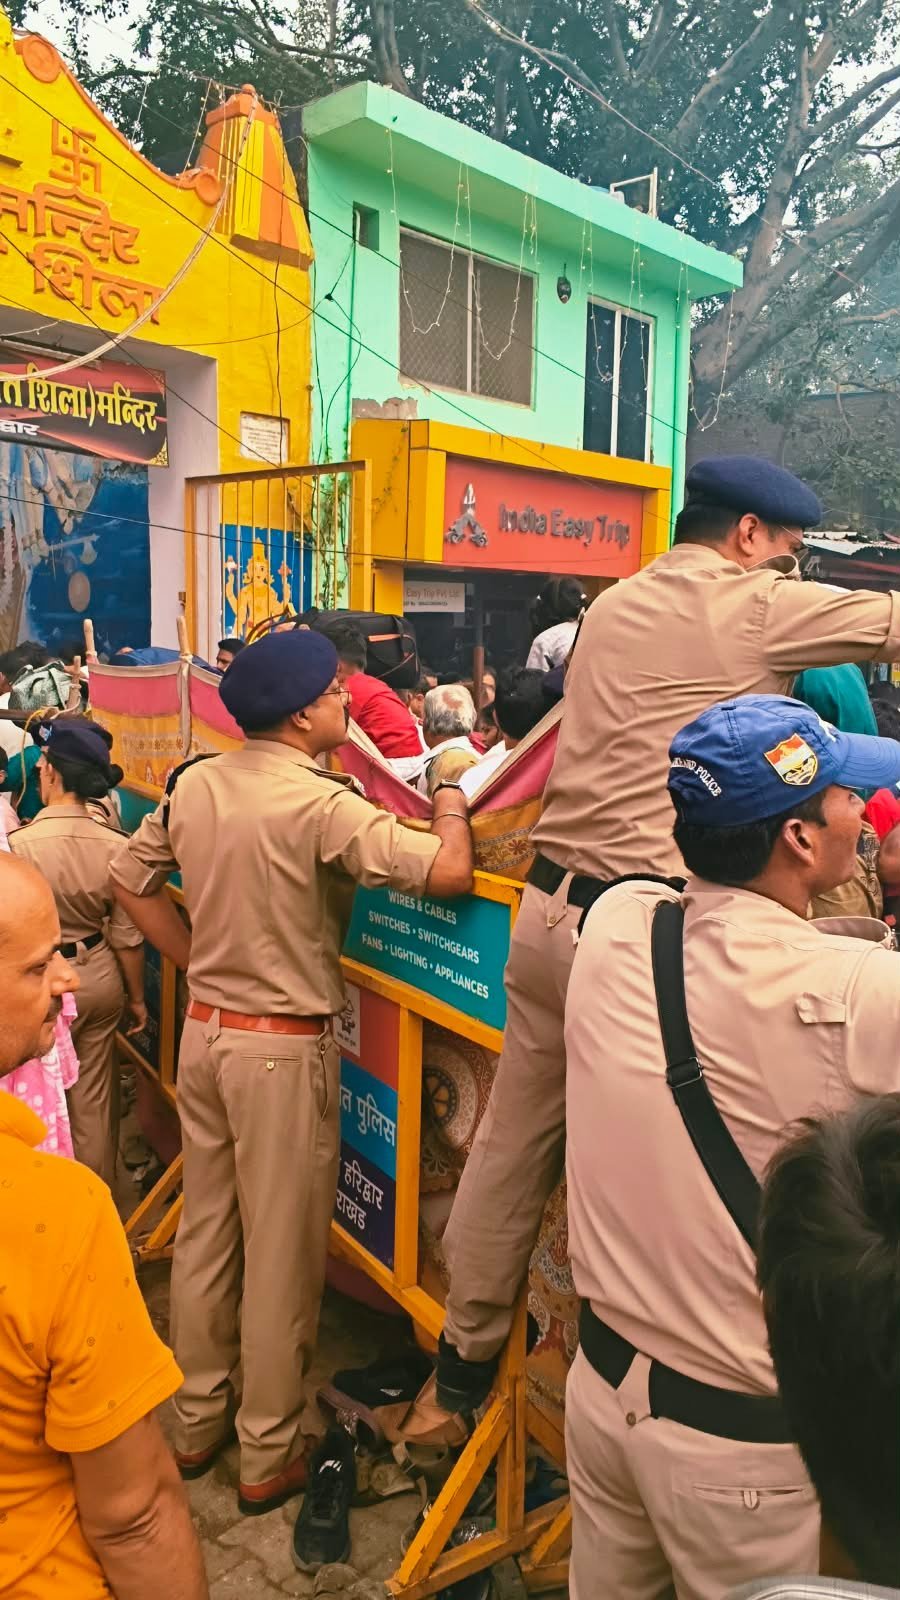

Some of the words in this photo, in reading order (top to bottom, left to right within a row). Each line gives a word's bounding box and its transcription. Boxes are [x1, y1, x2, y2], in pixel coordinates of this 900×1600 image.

[498, 503, 547, 535] India
[550, 508, 595, 547] Easy
[596, 514, 630, 551] Trip
[694, 765, 722, 797] POLICE
[388, 890, 416, 910] WIRES
[416, 900, 423, 912] &
[424, 902, 457, 925] CABLES
[368, 910, 411, 935] SWITCHES
[418, 928, 480, 964] SWITCHGEARS
[361, 933, 384, 952] FANS
[390, 944, 428, 970] LIGHTING
[434, 963, 489, 999] APPLIANCES
[356, 1092, 397, 1148] पुलिस
[344, 1159, 384, 1211] हरिद्वार
